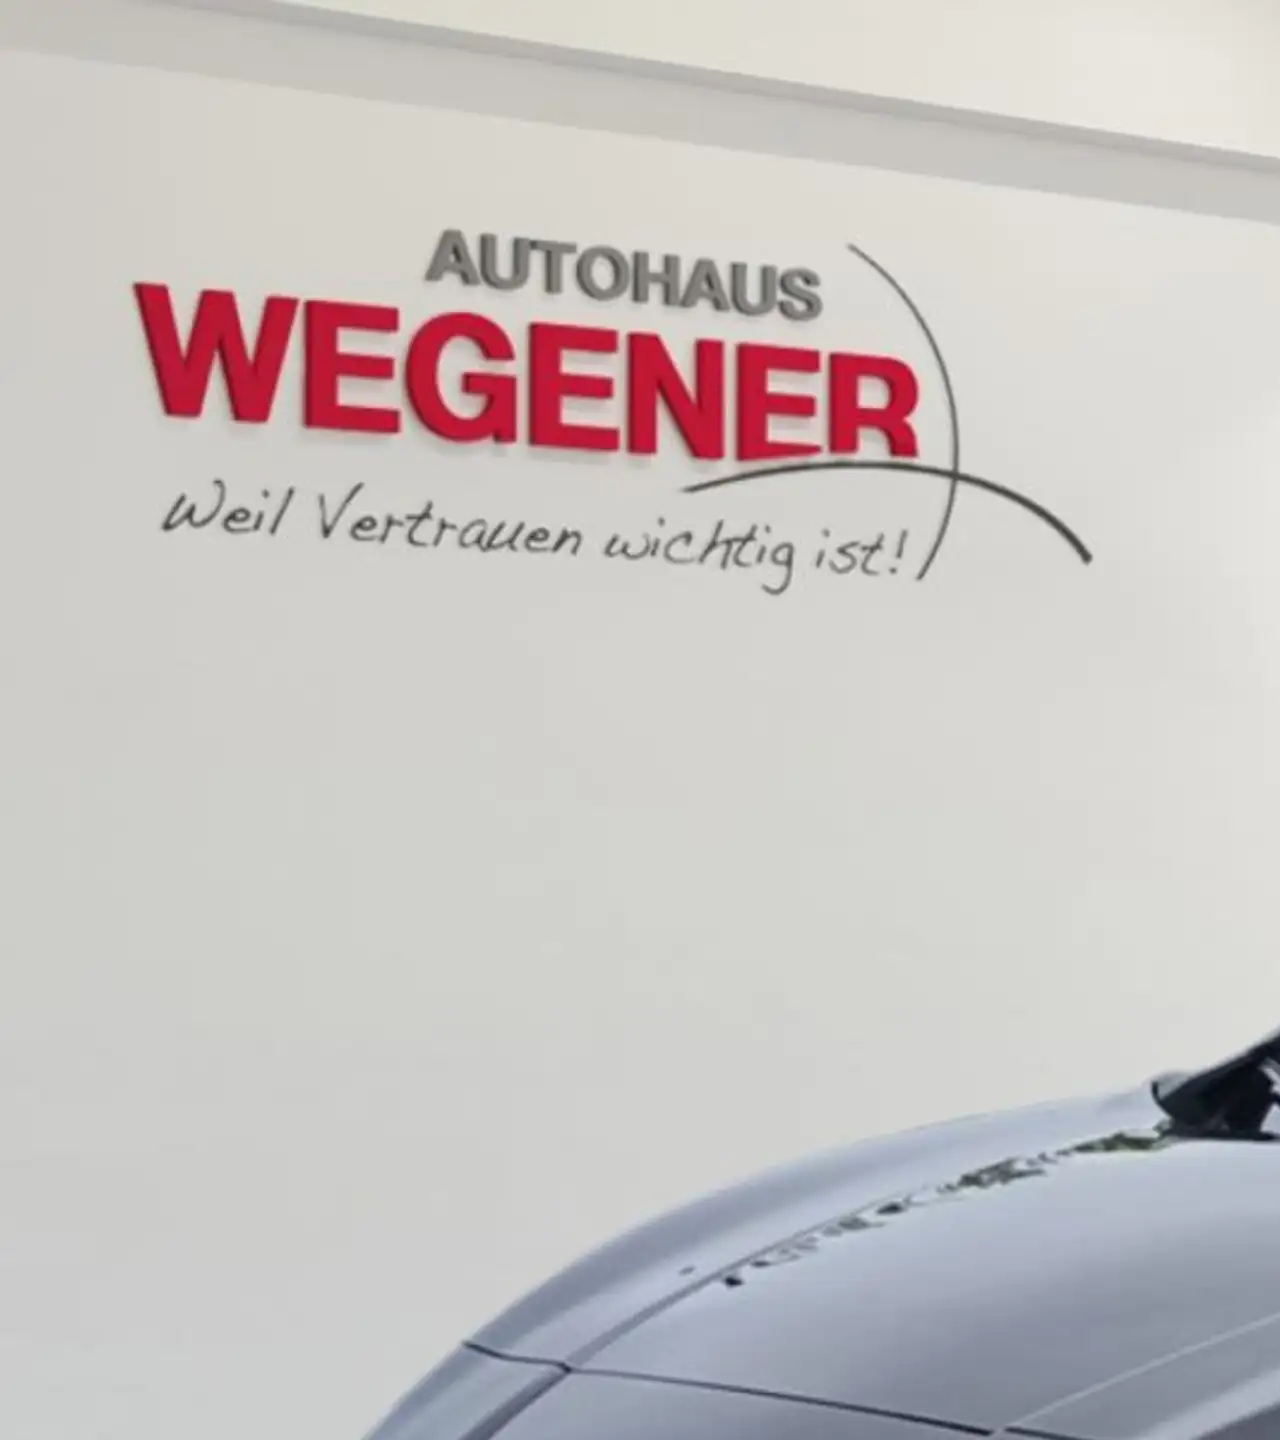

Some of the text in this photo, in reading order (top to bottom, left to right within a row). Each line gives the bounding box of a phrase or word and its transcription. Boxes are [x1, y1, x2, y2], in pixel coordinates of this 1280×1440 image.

[423, 228, 823, 322] AUTOHAUS
[133, 281, 921, 463] WEGENER
[160, 478, 909, 596] Weil Vertrauen wichtig ist!
